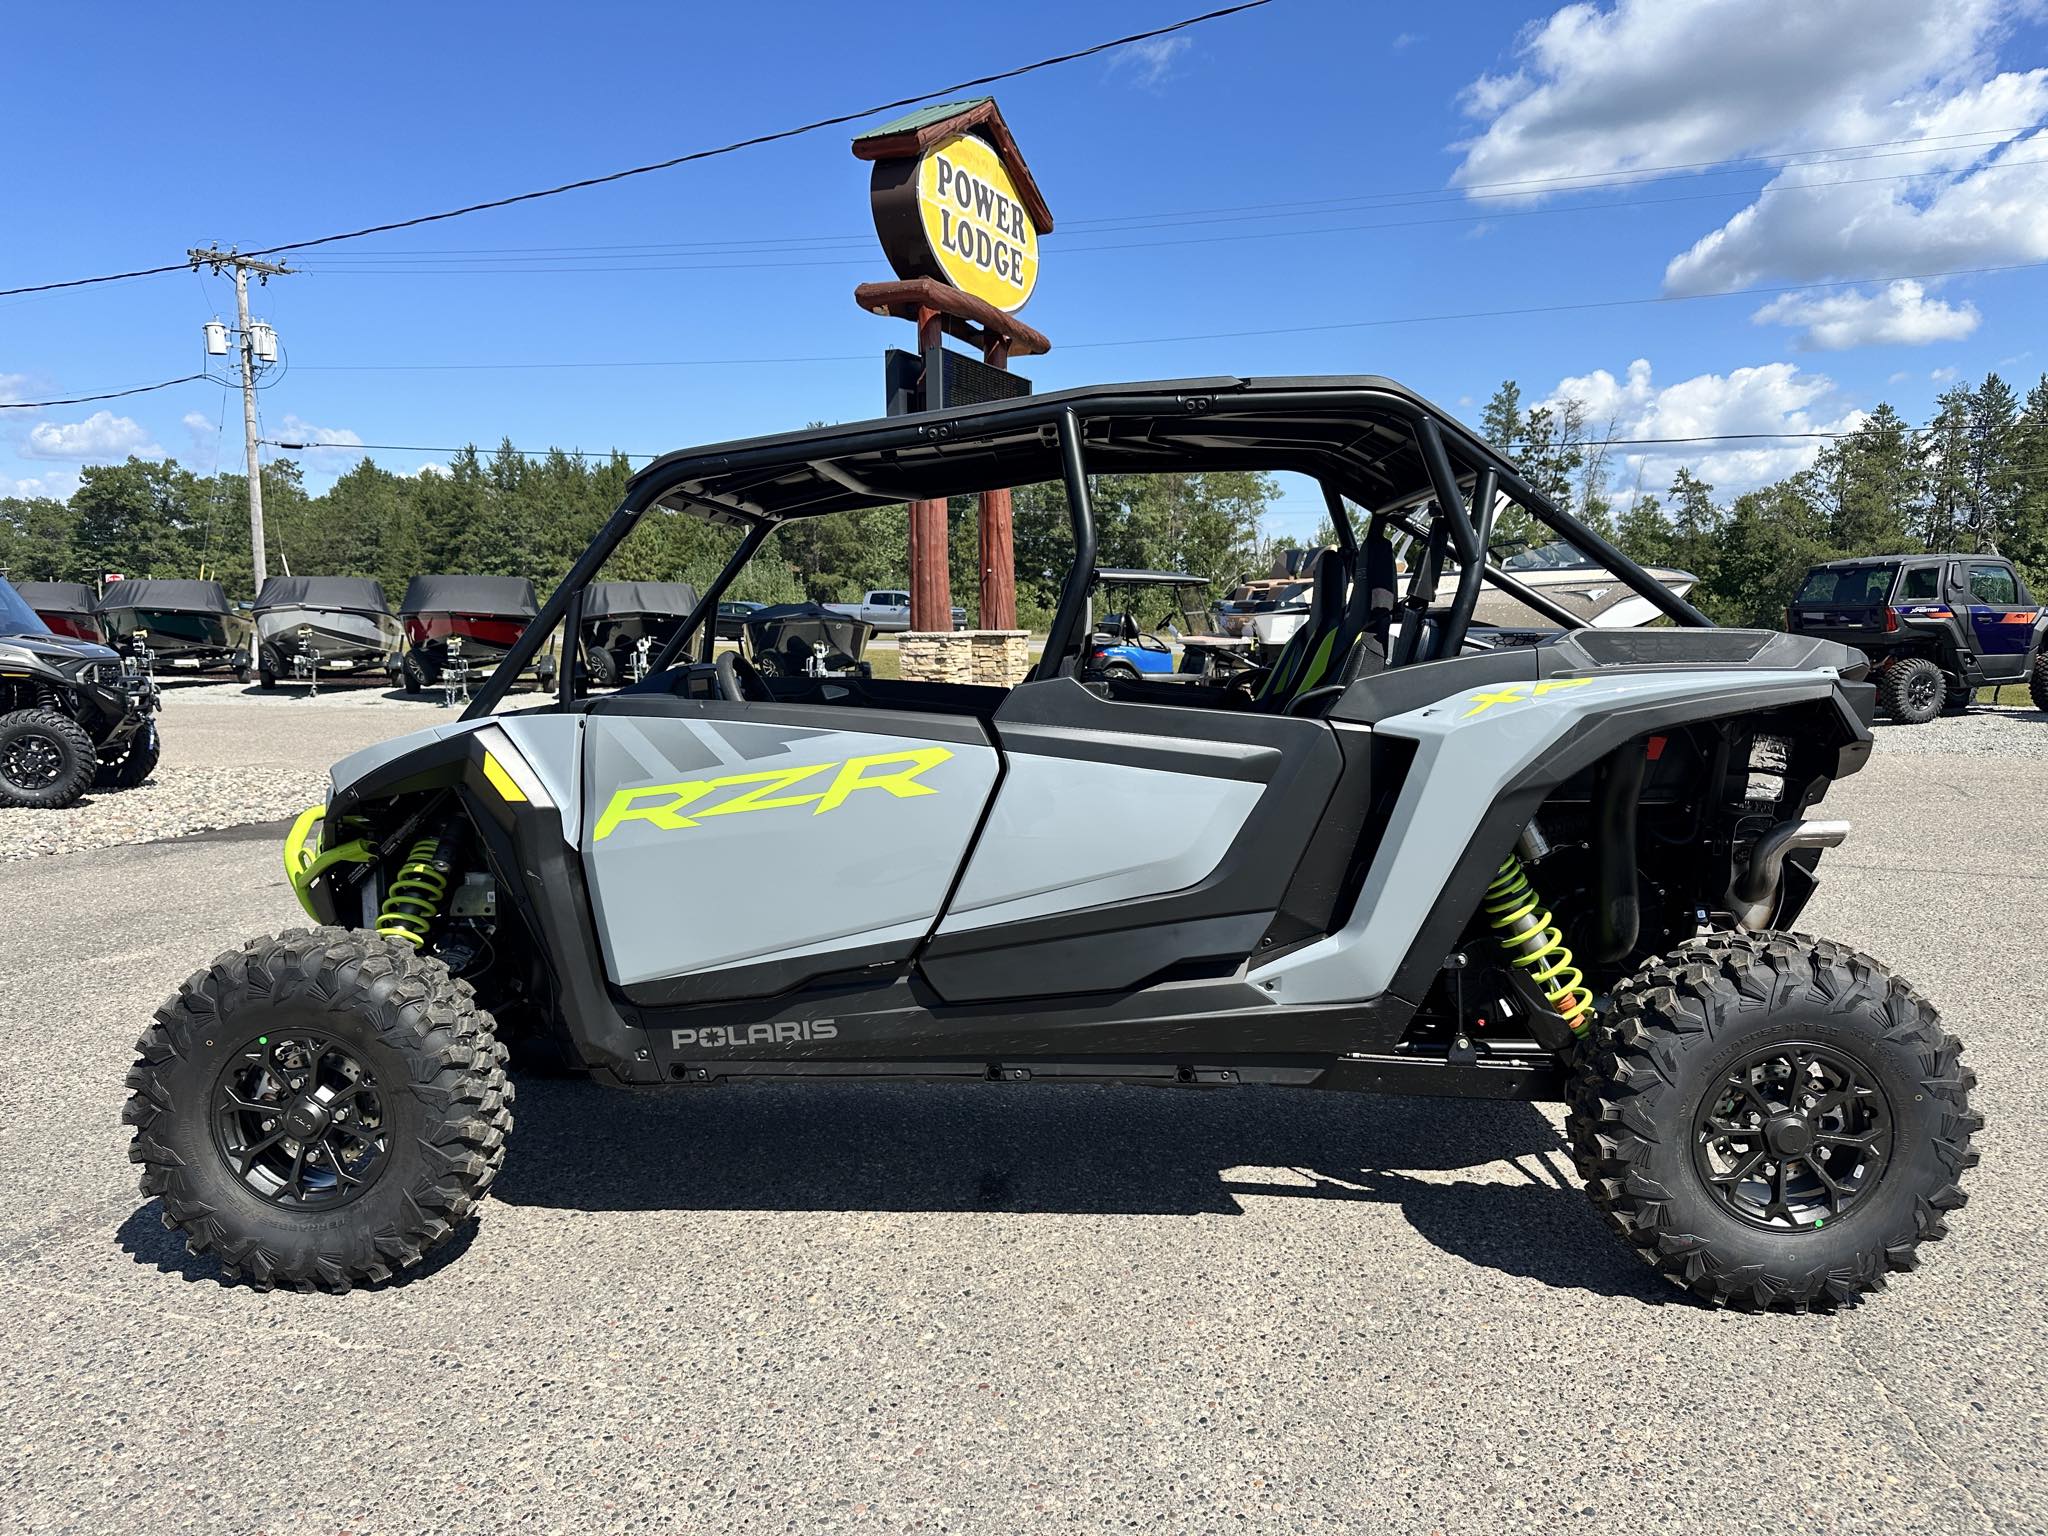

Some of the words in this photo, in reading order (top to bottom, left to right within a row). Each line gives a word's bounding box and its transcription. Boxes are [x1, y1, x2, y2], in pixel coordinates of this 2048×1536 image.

[936, 155, 1026, 245] POWER
[941, 208, 1024, 287] LODGE
[1459, 677, 1593, 720] XP
[593, 746, 955, 842] RZR
[671, 1018, 838, 1050] POLARIS
